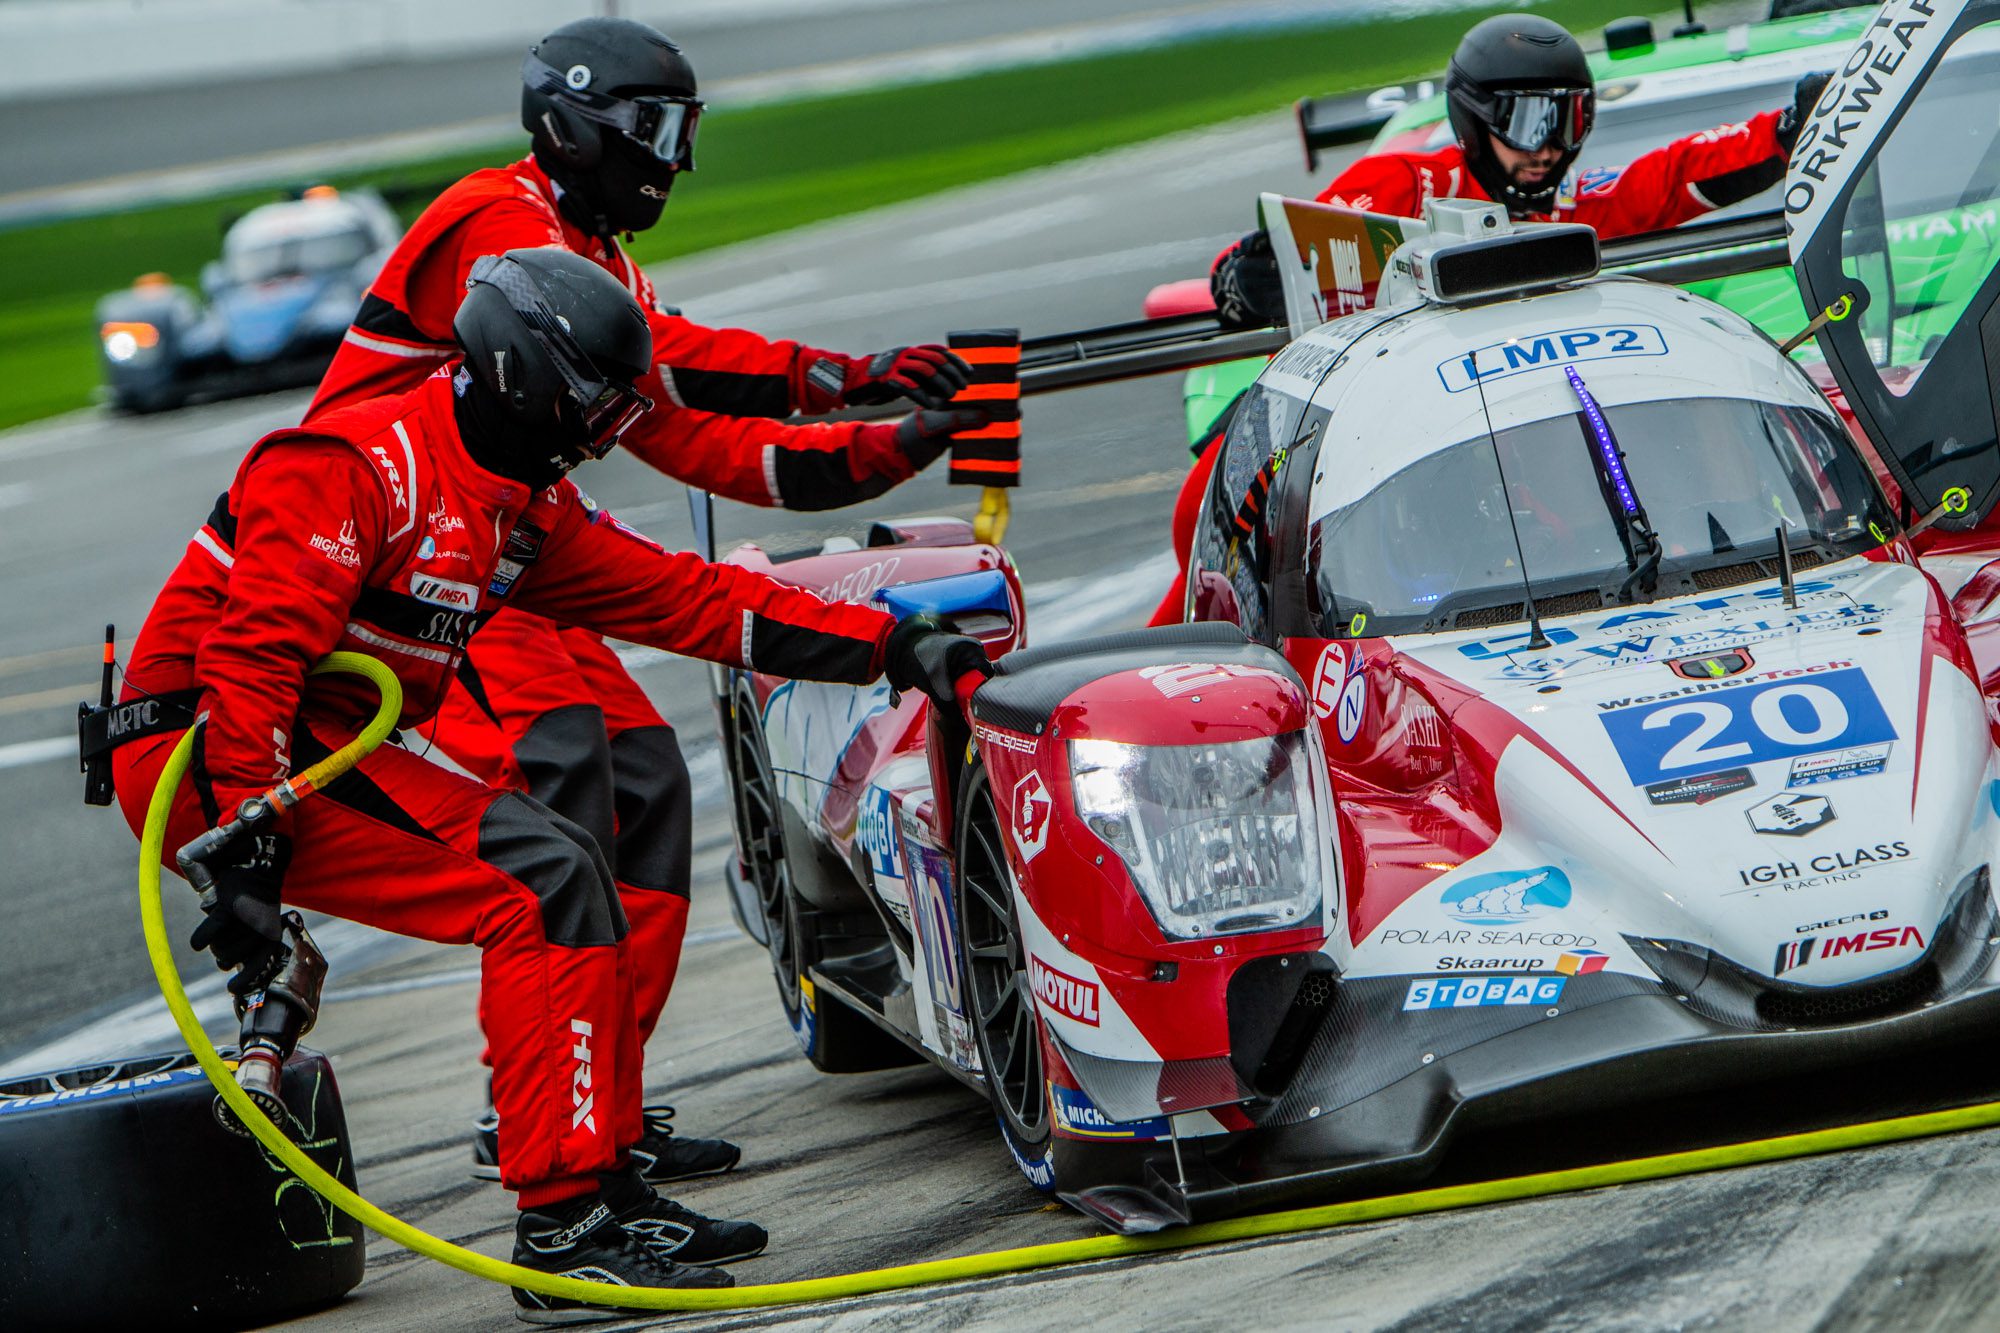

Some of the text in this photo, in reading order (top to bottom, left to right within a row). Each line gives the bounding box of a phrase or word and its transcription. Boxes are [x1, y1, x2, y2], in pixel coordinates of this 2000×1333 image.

[1461, 329, 1645, 381] LMP2
[371, 446, 407, 509] HRX
[310, 533, 361, 566] HIGH CLA
[326, 552, 353, 567] RACING
[437, 588, 469, 605] IMSA
[1723, 592, 1845, 615] Baning
[1576, 603, 1887, 658] WEXLER
[1316, 650, 1342, 713] E
[1597, 660, 1853, 710] WeatherTech
[107, 700, 160, 740] MRTC
[1345, 684, 1360, 732] N
[1400, 704, 1442, 748] SASHI
[1641, 684, 1850, 771] 20
[1810, 841, 1911, 873] CLASS
[1783, 870, 1862, 892] RACING
[1380, 929, 1598, 948] POLAR SEAFOOD
[1820, 926, 1925, 959] IMSA
[1436, 956, 1544, 972] Skaarup
[1034, 960, 1098, 1022] MOTUL
[1411, 982, 1559, 1003] STOBAG
[571, 1018, 597, 1135] HRX
